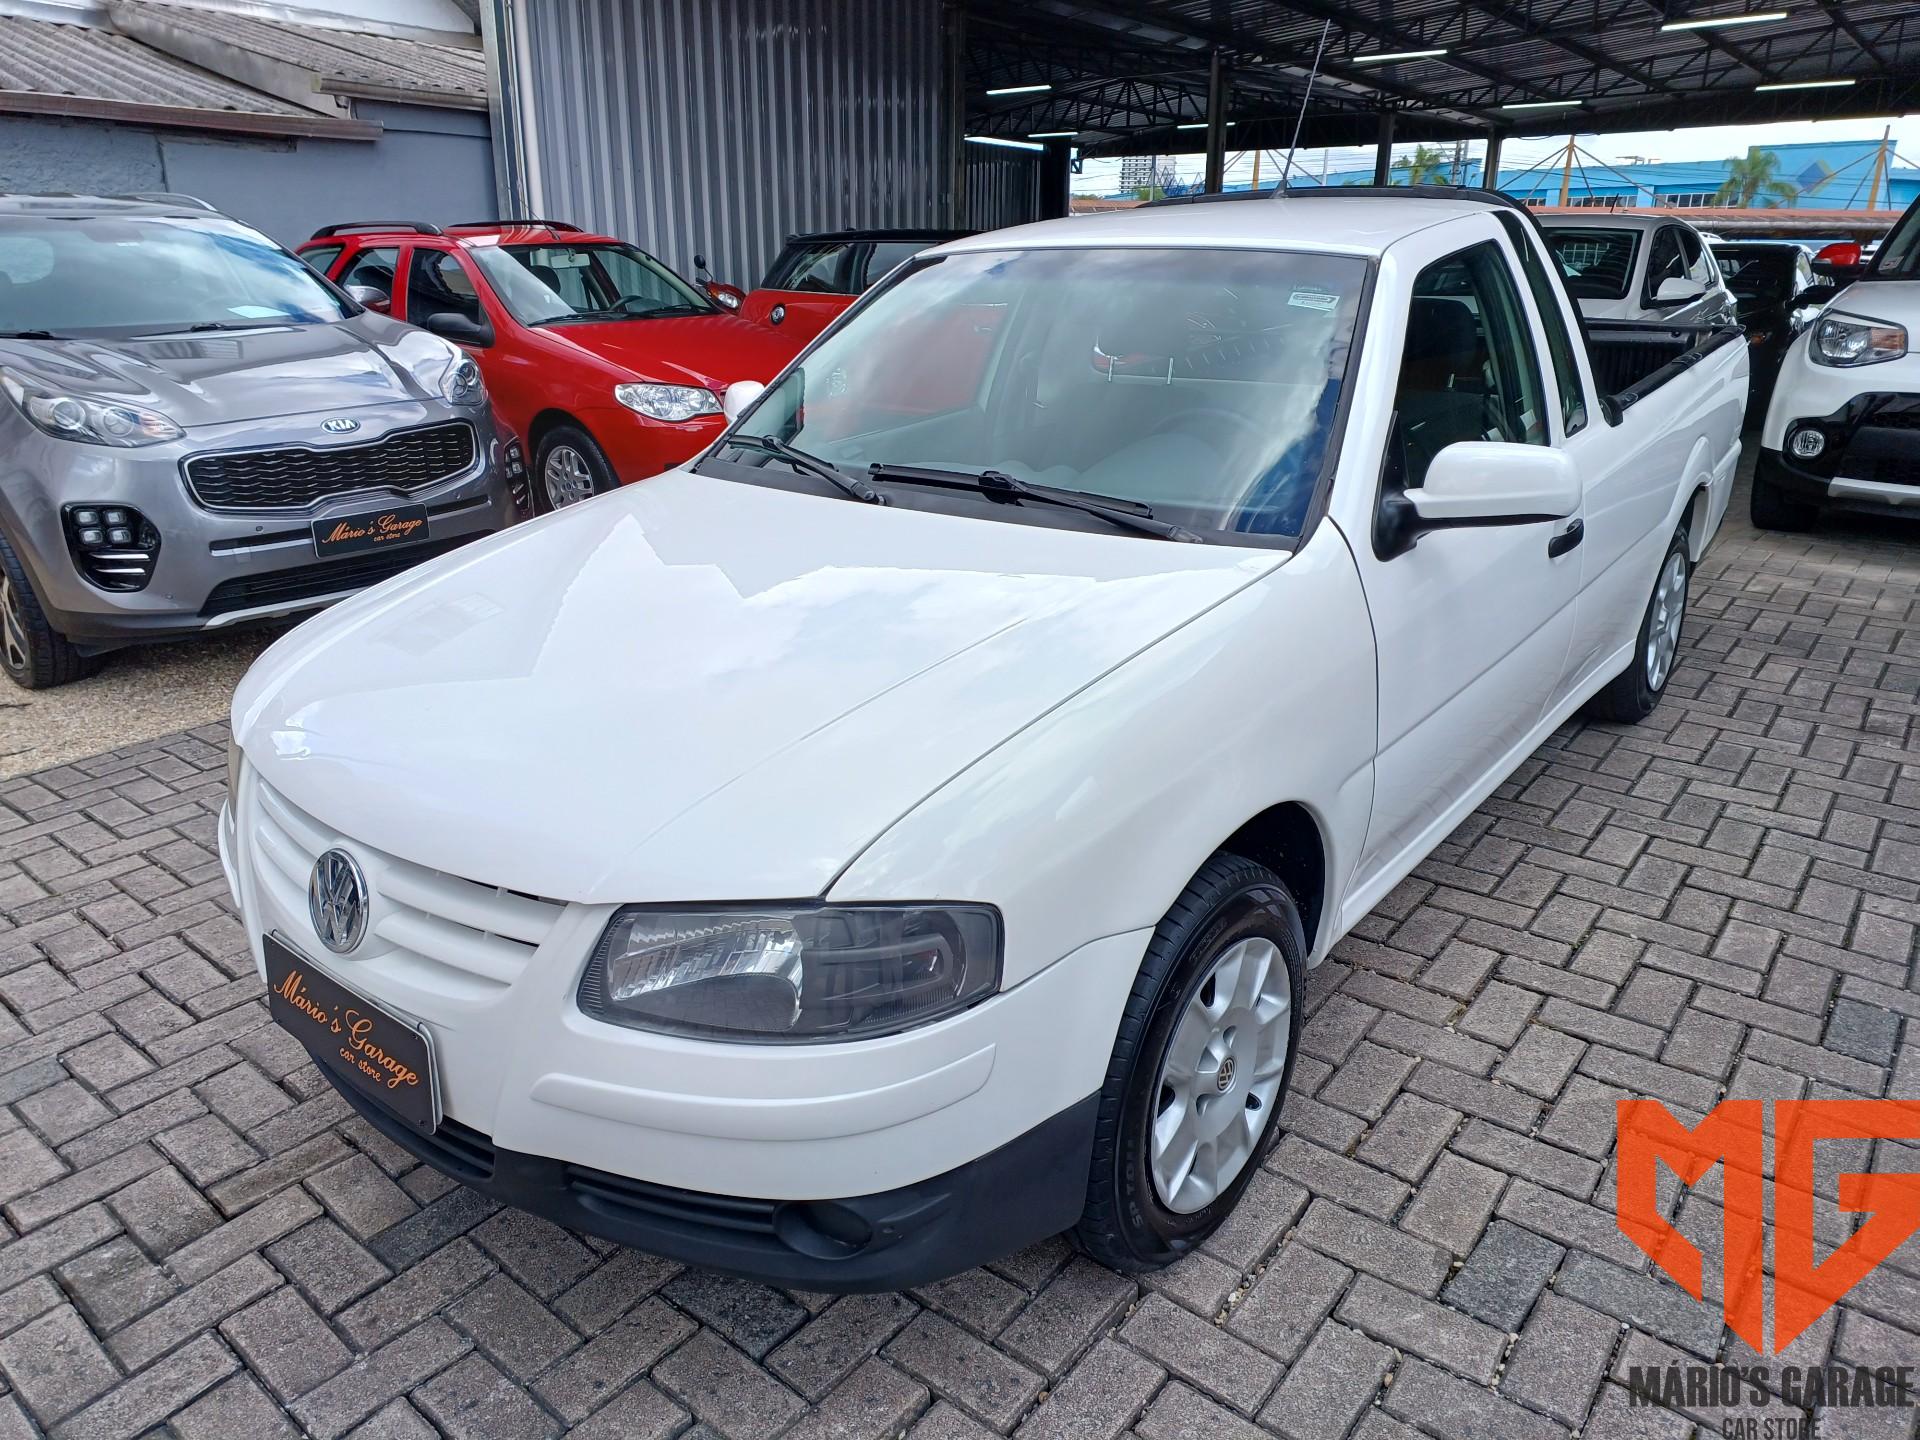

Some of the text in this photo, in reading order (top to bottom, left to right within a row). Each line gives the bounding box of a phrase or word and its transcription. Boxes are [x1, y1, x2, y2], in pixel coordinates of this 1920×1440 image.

[326, 418, 357, 432] KIA
[377, 513, 423, 536] Garage
[345, 1009, 420, 1090] Garage
[339, 1047, 383, 1083] car store
